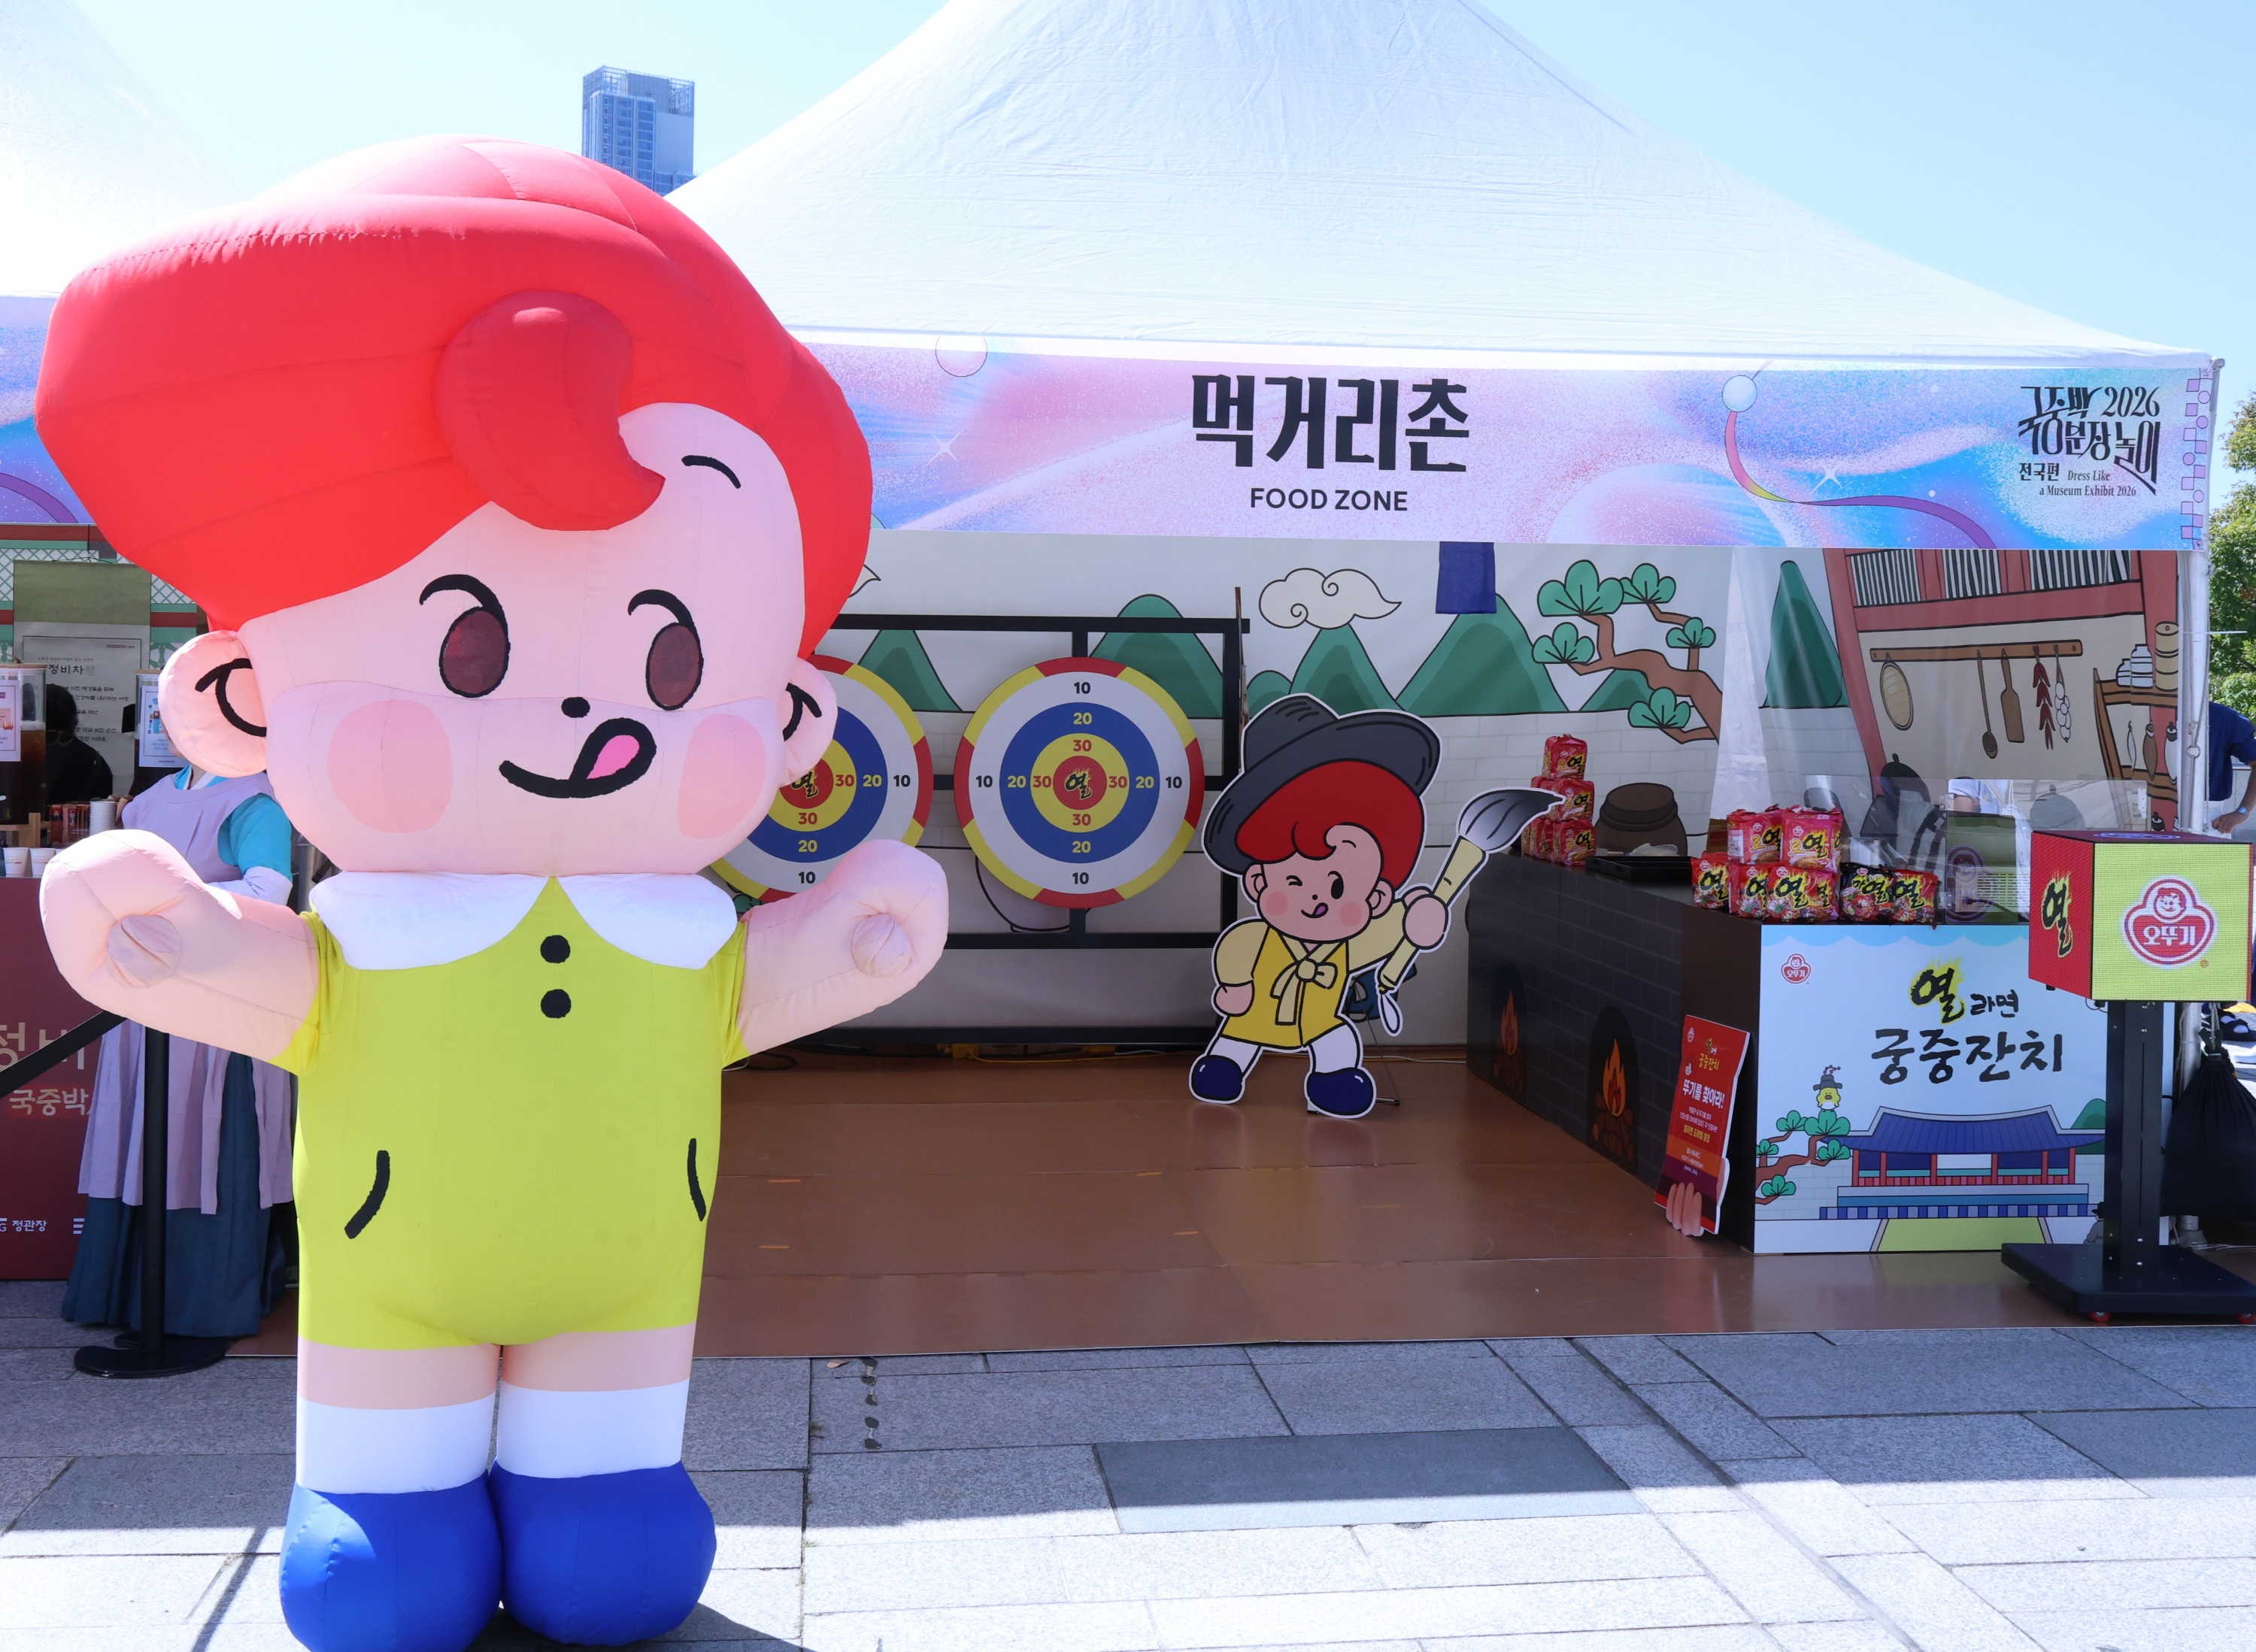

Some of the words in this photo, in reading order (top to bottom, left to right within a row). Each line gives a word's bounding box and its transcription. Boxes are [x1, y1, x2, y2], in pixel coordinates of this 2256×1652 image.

[2100, 386, 2160, 417] 2026
[1192, 374, 1469, 472] 먹거리촌
[2064, 420, 2161, 496] 분장놀이
[2019, 462, 2060, 481] 전국편
[2068, 470, 2091, 481] Dress
[2093, 470, 2111, 481] Like
[1250, 487, 1327, 510] FOOD
[1335, 490, 1408, 511] ZONE
[2039, 487, 2045, 496] a
[2047, 485, 2082, 496] Museum
[2085, 485, 2115, 496] Exhibit
[2116, 485, 2136, 496] 2026
[48, 664, 84, 675] 정비차
[1074, 681, 1091, 694] 10
[1073, 712, 1092, 725] 20
[1072, 739, 1092, 752] 30
[791, 771, 819, 799] 열
[835, 774, 855, 787] 30
[863, 774, 882, 787] 20
[893, 774, 911, 787] 10
[976, 775, 993, 788] 10
[1007, 775, 1026, 788] 20
[1032, 775, 1052, 788] 30
[1065, 772, 1093, 800] 열
[1108, 776, 1127, 788] 30
[1136, 776, 1154, 789] 20
[1166, 776, 1182, 789] 10
[798, 812, 817, 825] 30
[1072, 814, 1091, 826] 30
[798, 840, 817, 853] 20
[1072, 841, 1091, 853] 20
[798, 871, 816, 884] 10
[1072, 872, 1089, 885] 10
[1700, 870, 1729, 901] 열
[1775, 877, 1809, 909] 열
[1894, 879, 1925, 909] 열
[2042, 878, 2073, 958] 열
[2142, 925, 2196, 947] 오뚜기
[1787, 969, 1806, 978] 오뚜기
[1910, 967, 2019, 1024] 열라면
[1699, 1053, 1720, 1071] 궁중잔치
[1871, 1028, 2063, 1085] 궁중잔치
[9, 1087, 90, 1116] 국중박
[1682, 1078, 1703, 1101] 뚜기를
[1702, 1086, 1726, 1109] 찾아라!
[12, 1220, 47, 1232] 정관장
